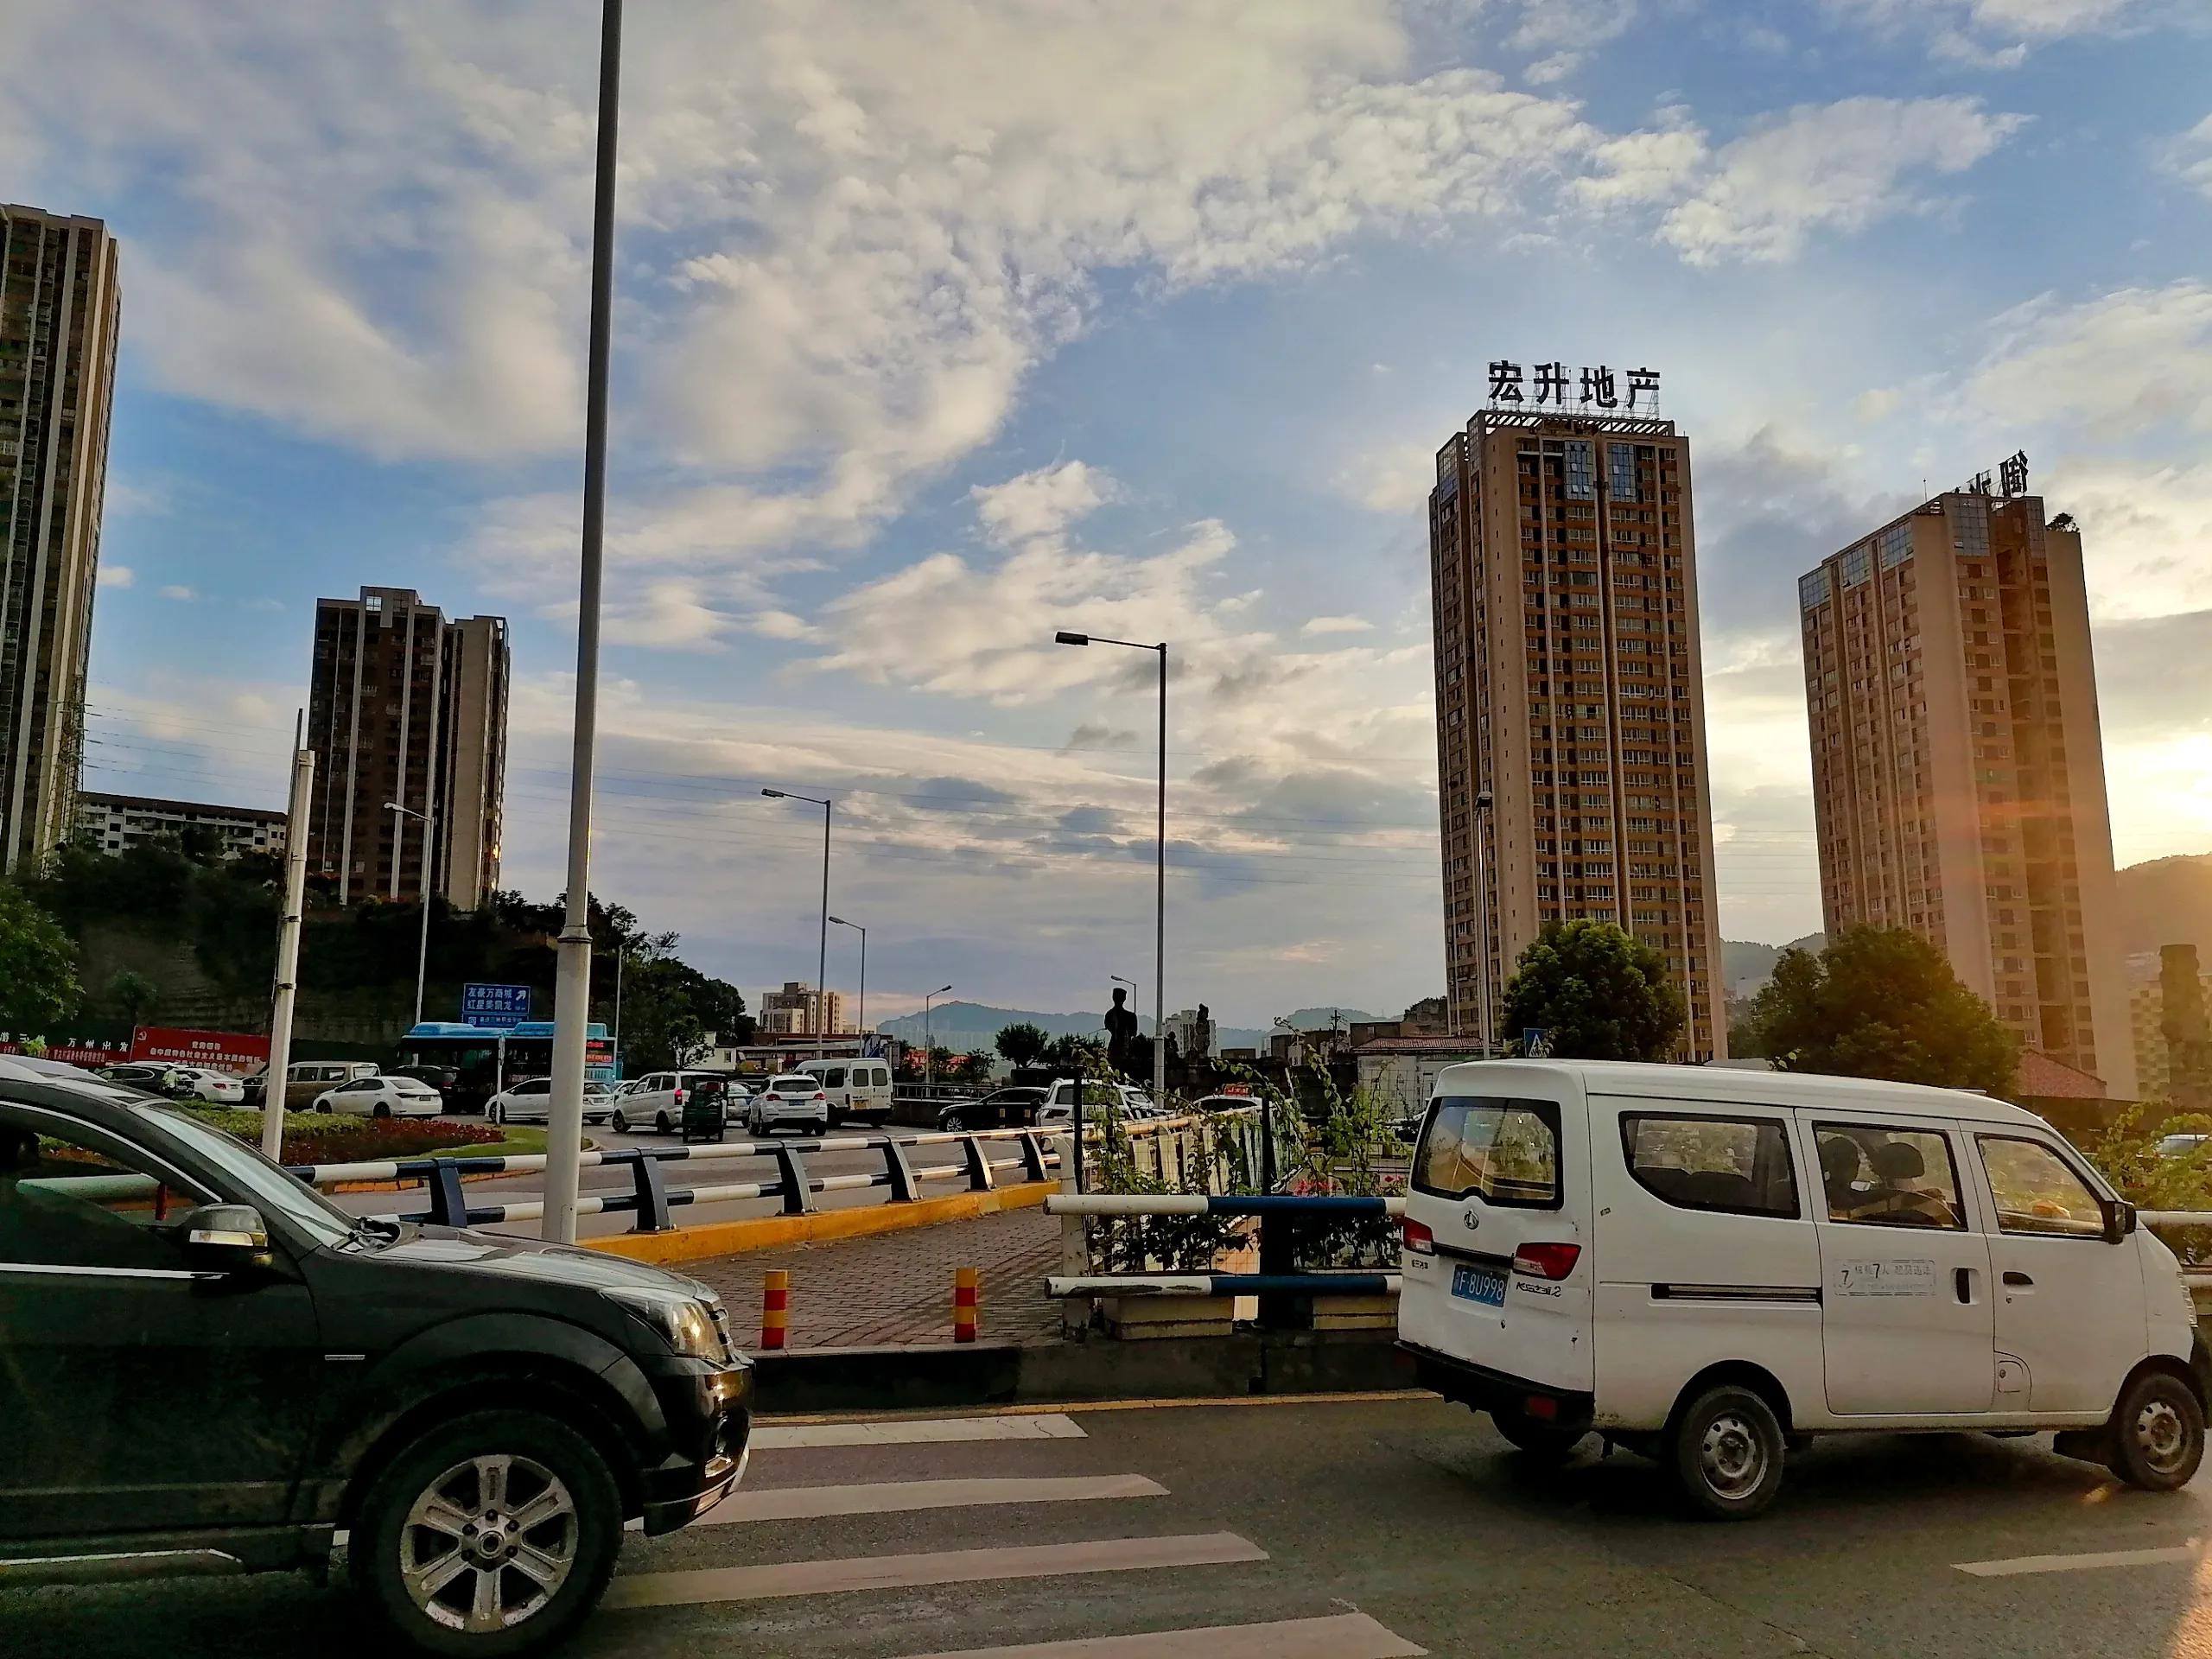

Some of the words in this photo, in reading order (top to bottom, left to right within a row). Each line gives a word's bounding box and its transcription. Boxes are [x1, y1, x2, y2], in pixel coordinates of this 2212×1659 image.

[1488, 359, 1661, 409] 宏升地产
[467, 999, 512, 1011] 红星美凯龙
